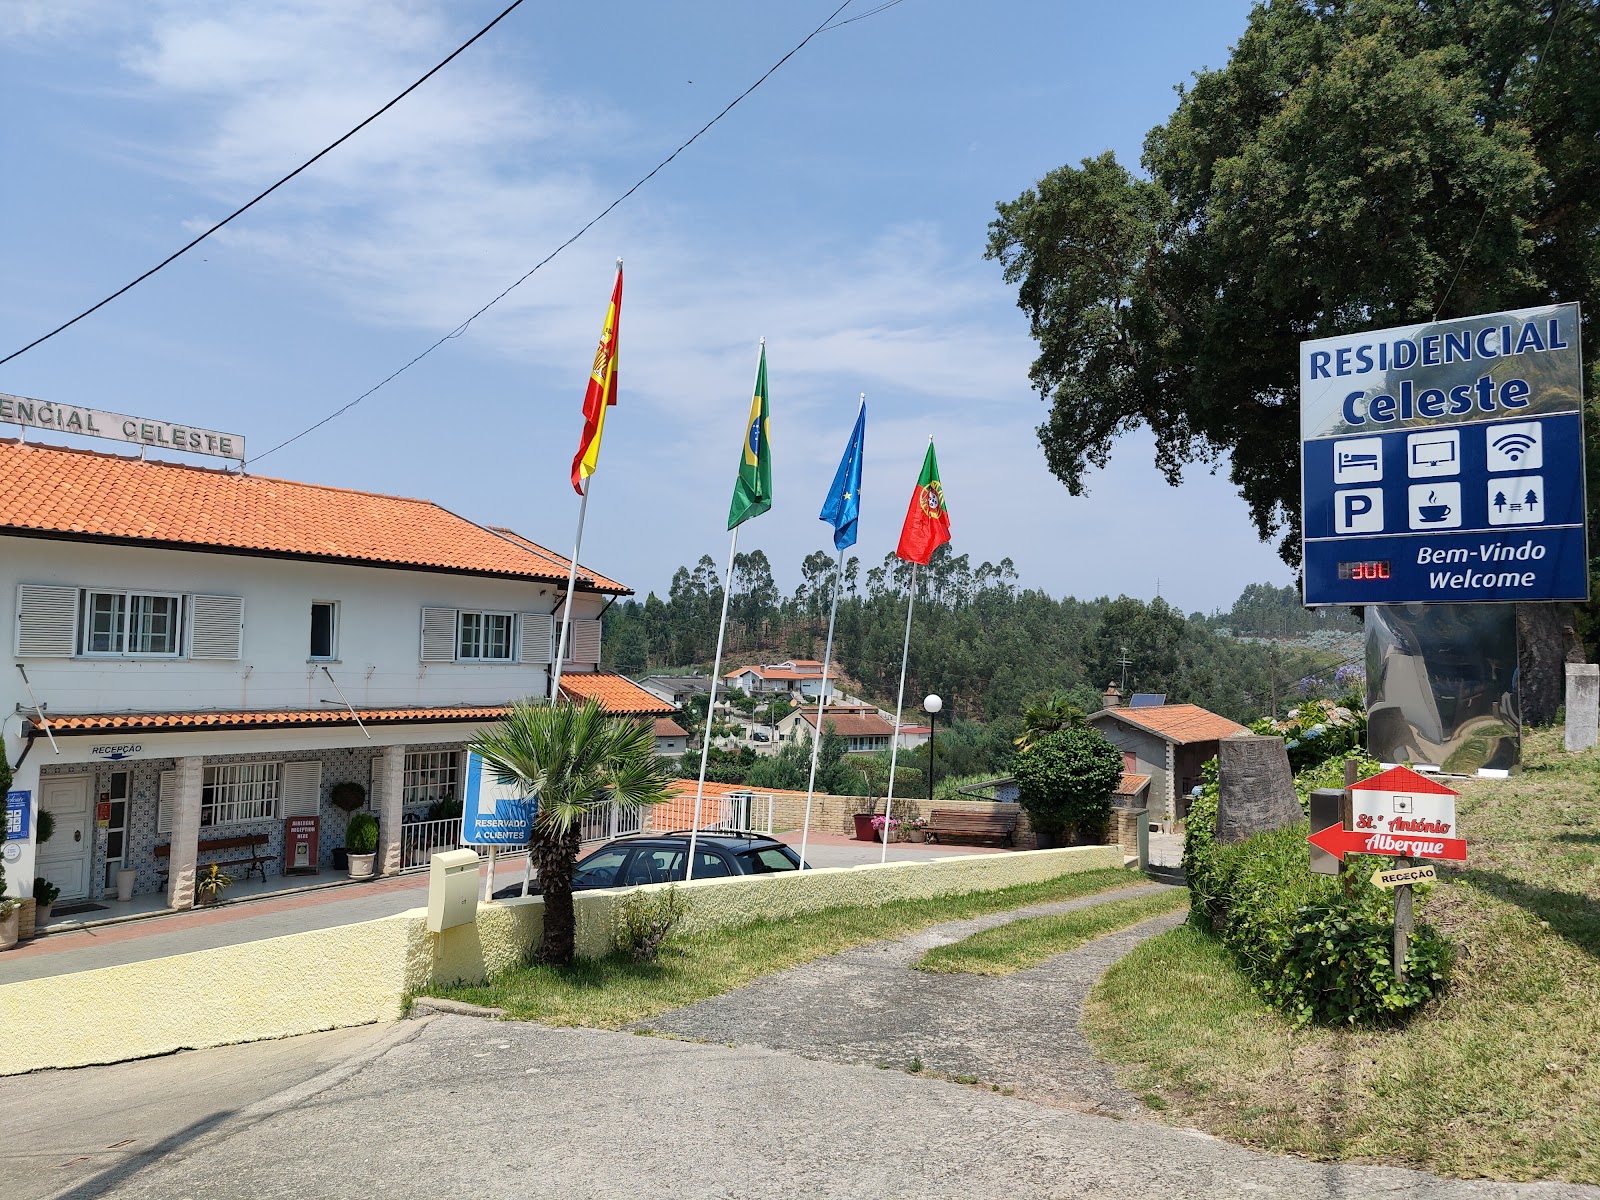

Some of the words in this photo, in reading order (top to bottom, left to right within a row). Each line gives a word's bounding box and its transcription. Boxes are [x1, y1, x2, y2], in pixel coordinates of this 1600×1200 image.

[1309, 318, 1568, 381] RESIDENCIAL
[1341, 374, 1531, 426] Celeste
[122, 420, 232, 454] CELESTE
[1344, 494, 1373, 528] P
[1416, 539, 1546, 565] Bem-Vindo
[1428, 568, 1537, 590] Welcome
[91, 744, 142, 755] RECEPÇÃO
[475, 819, 527, 828] RESERVADO
[1387, 816, 1451, 835] António
[475, 831, 482, 839] A
[483, 831, 525, 840] CLIENTES
[1364, 833, 1445, 857] Albergue
[1381, 869, 1434, 884] RECEÇÃO
